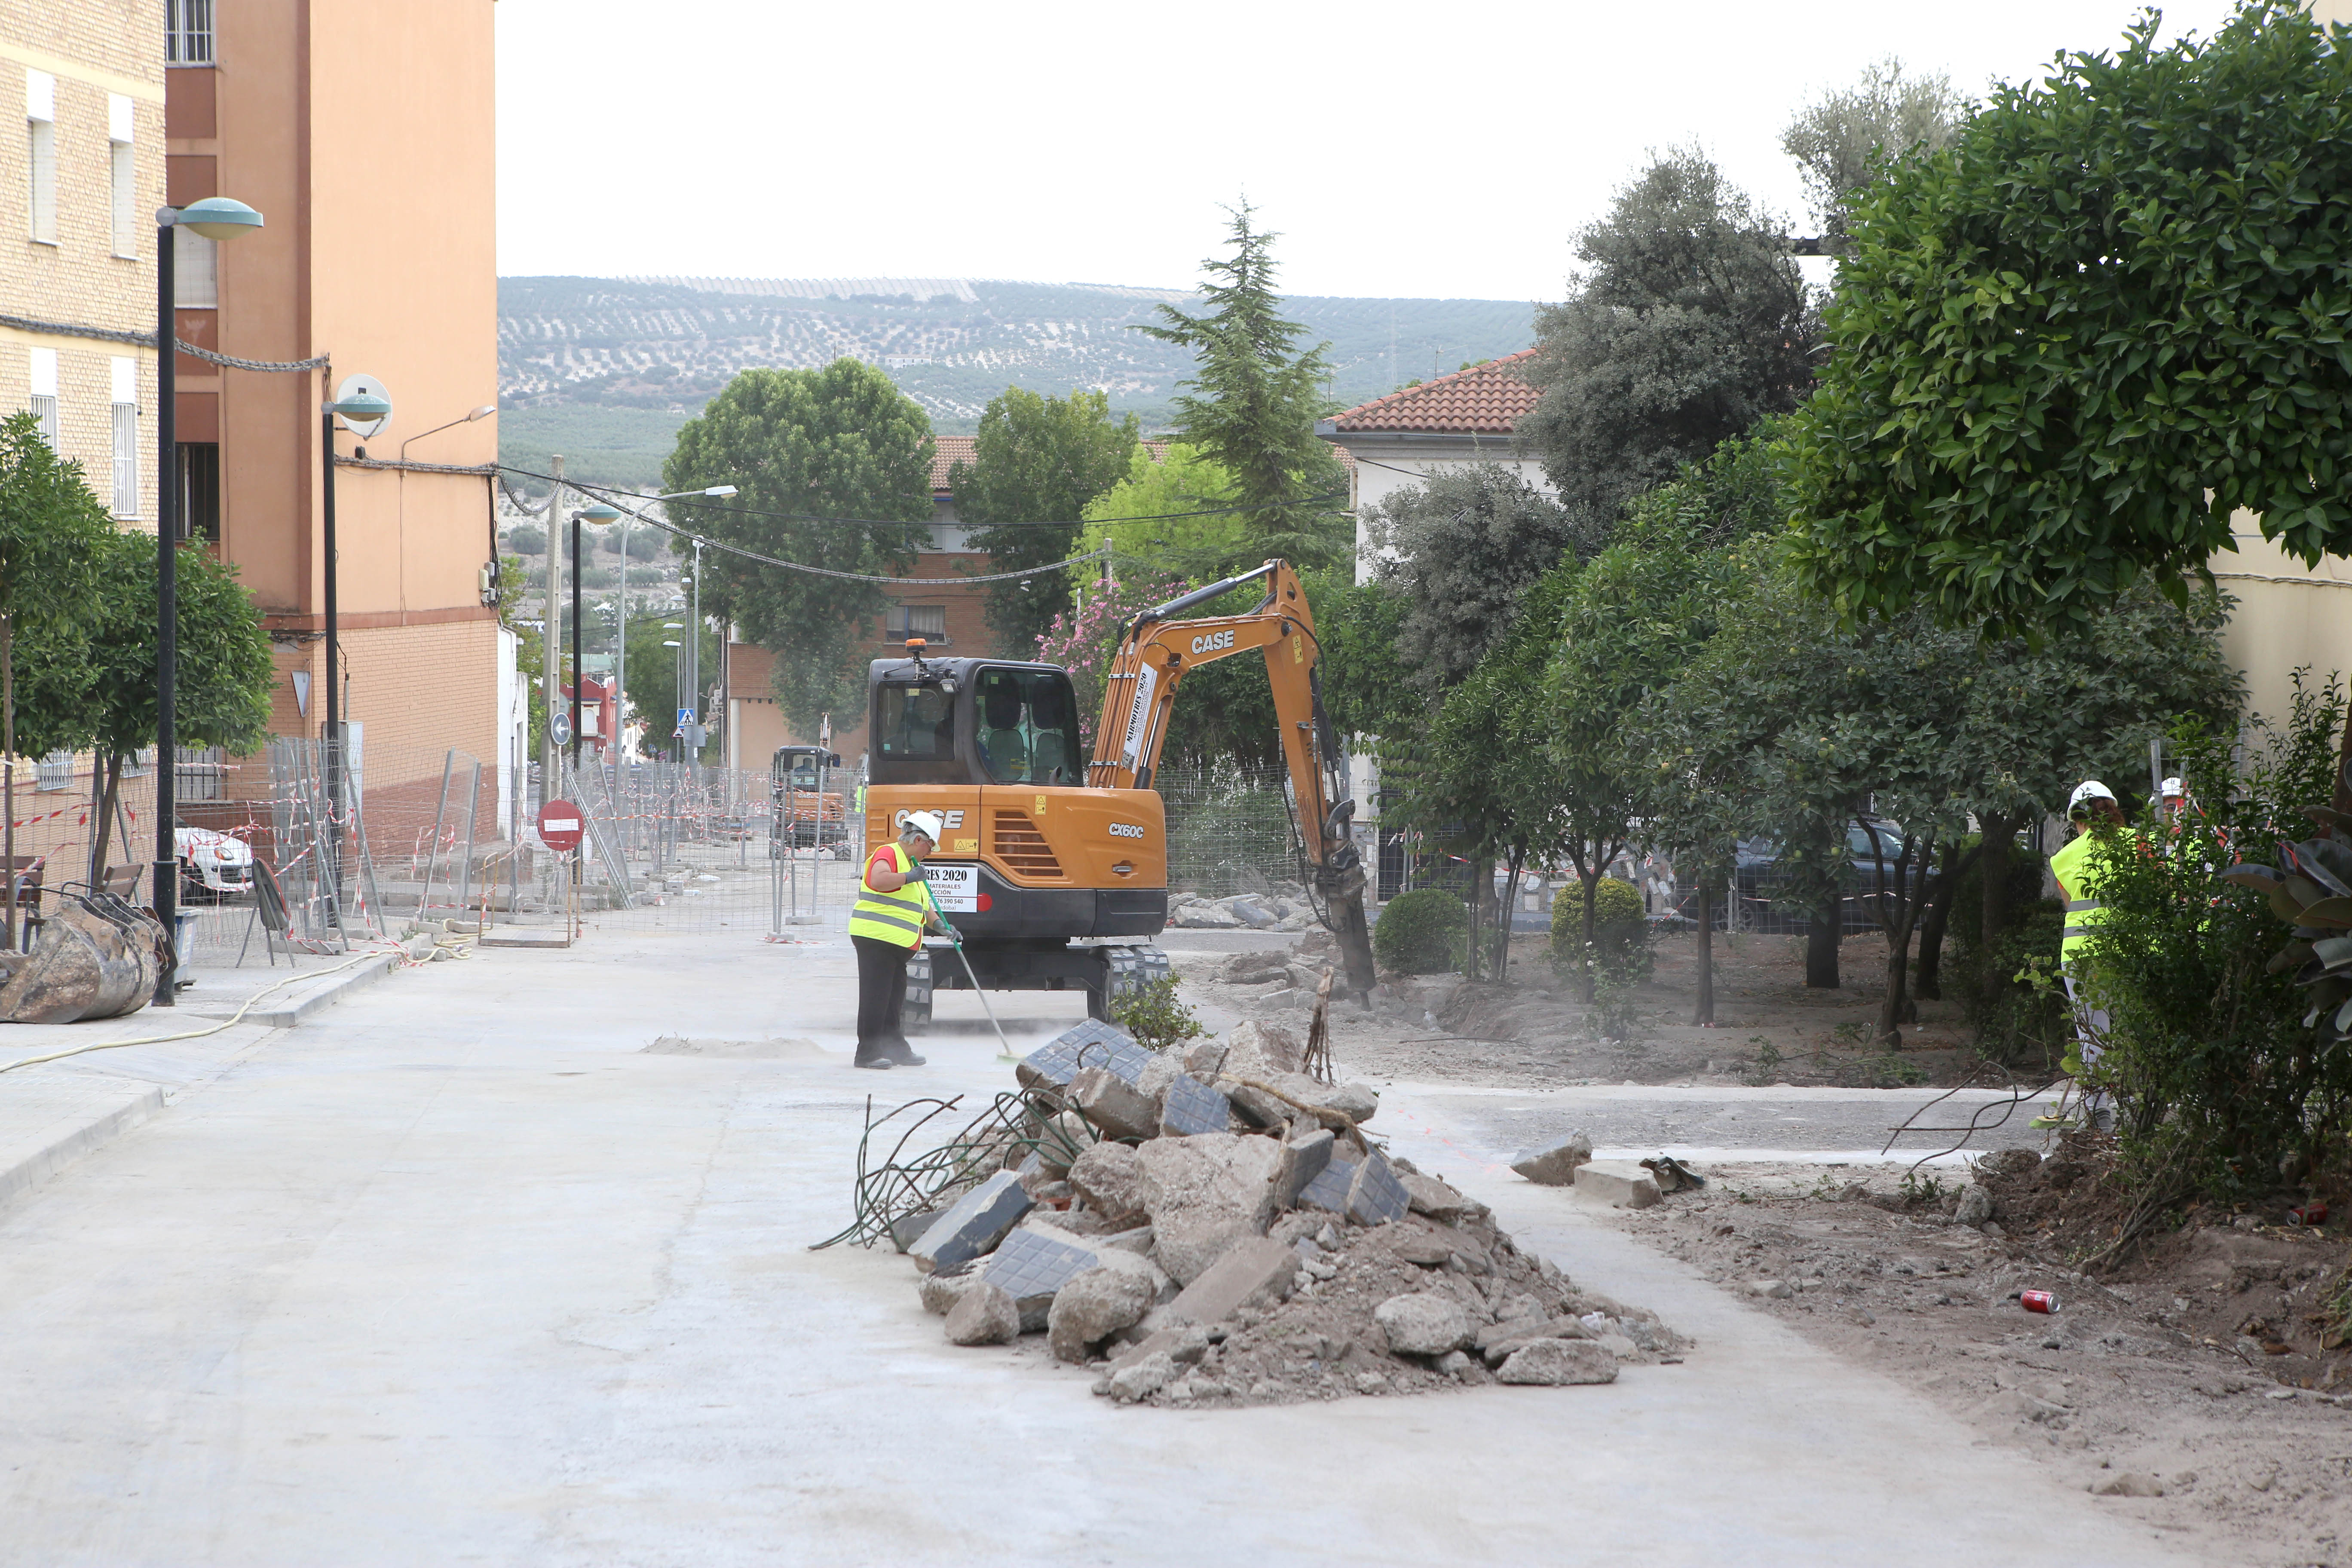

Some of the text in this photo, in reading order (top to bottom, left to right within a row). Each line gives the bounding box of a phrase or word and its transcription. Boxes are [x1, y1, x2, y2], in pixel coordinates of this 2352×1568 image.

[1191, 629, 1234, 655] CASE
[1127, 694, 1142, 744] MARMOTRES
[1138, 672, 1147, 695] 2020
[894, 808, 965, 829] CSE
[1109, 822, 1144, 839] CX60C
[943, 870, 967, 881] 2020
